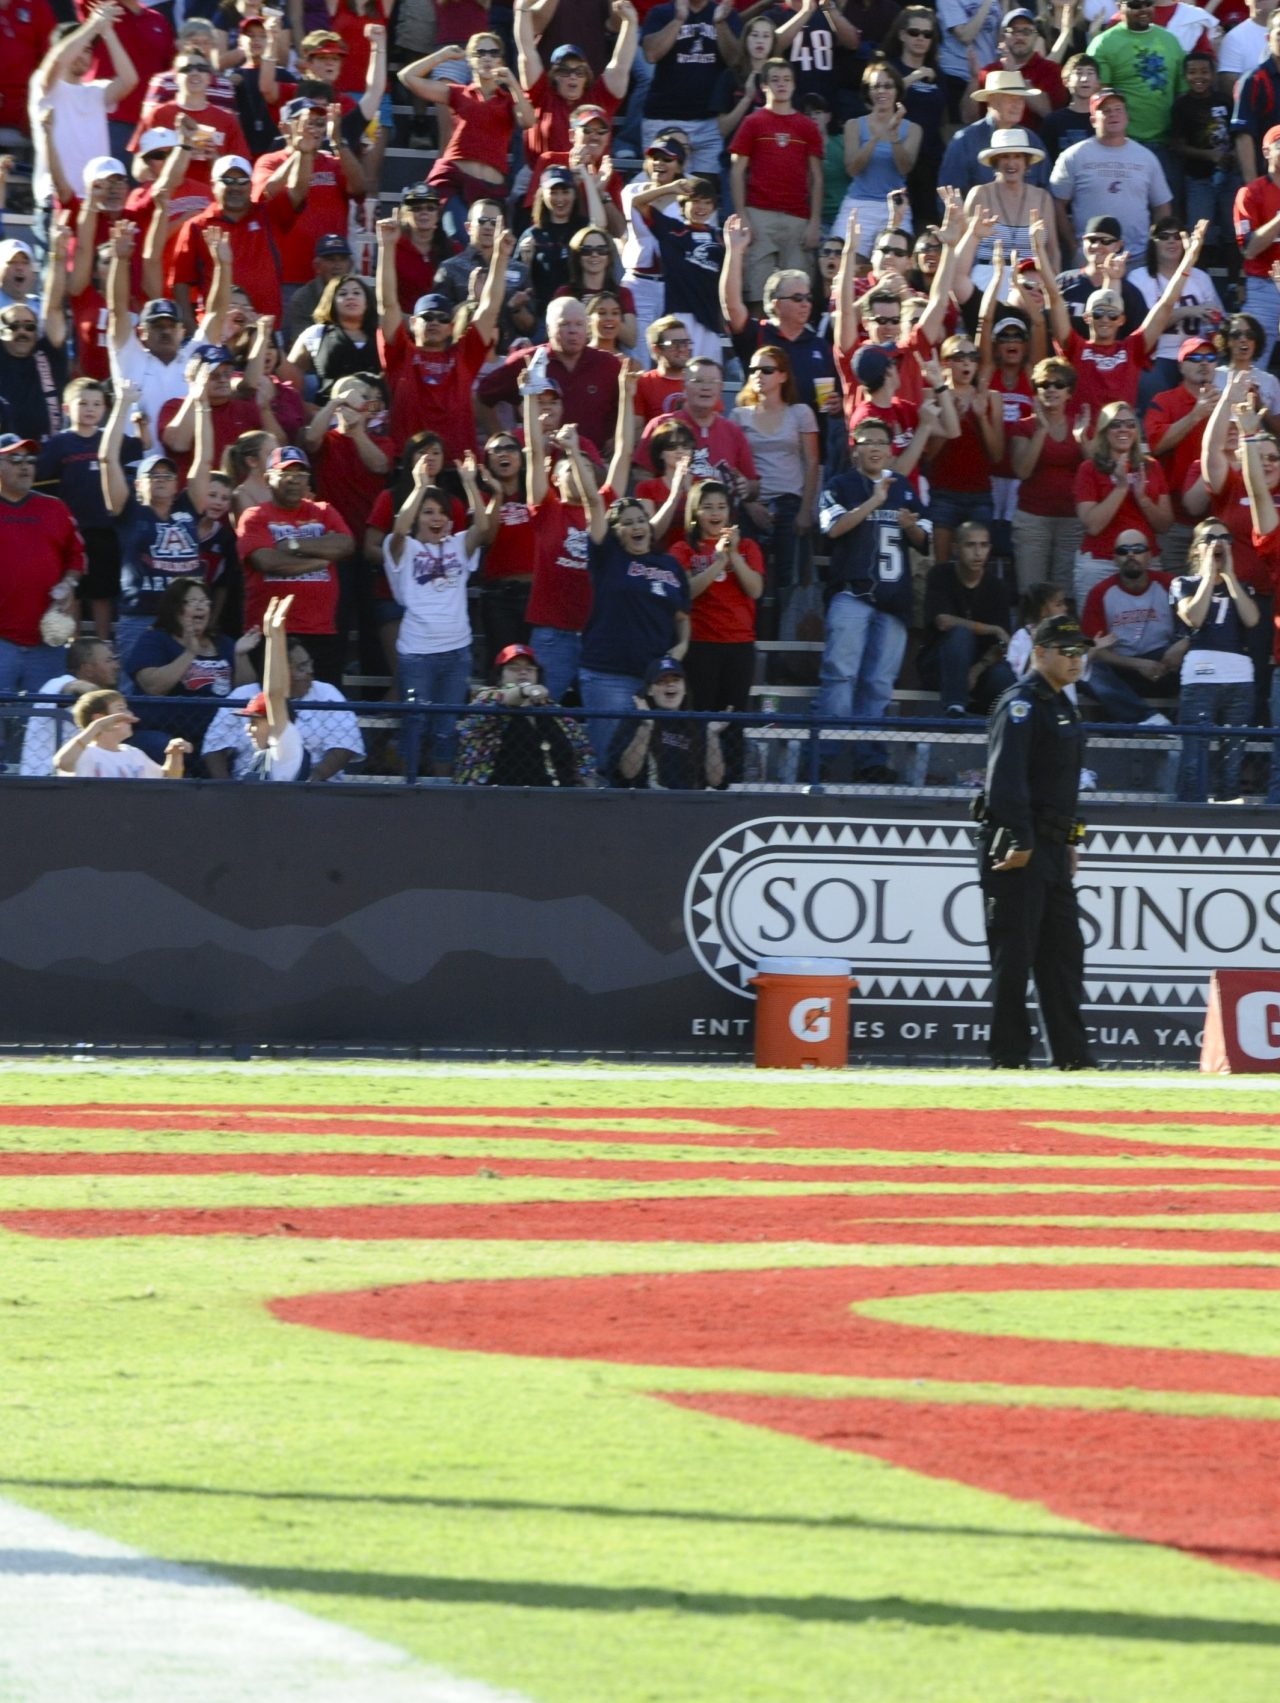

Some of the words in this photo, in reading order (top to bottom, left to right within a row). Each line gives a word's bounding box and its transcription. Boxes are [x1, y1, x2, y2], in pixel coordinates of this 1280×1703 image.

[790, 30, 833, 71] 48
[150, 522, 199, 558] A
[879, 524, 904, 582] 5
[1212, 597, 1230, 624] 7
[758, 877, 914, 945] SOL
[789, 997, 832, 1042] G
[900, 1022, 938, 1039] OF
[952, 1023, 991, 1041] TH
